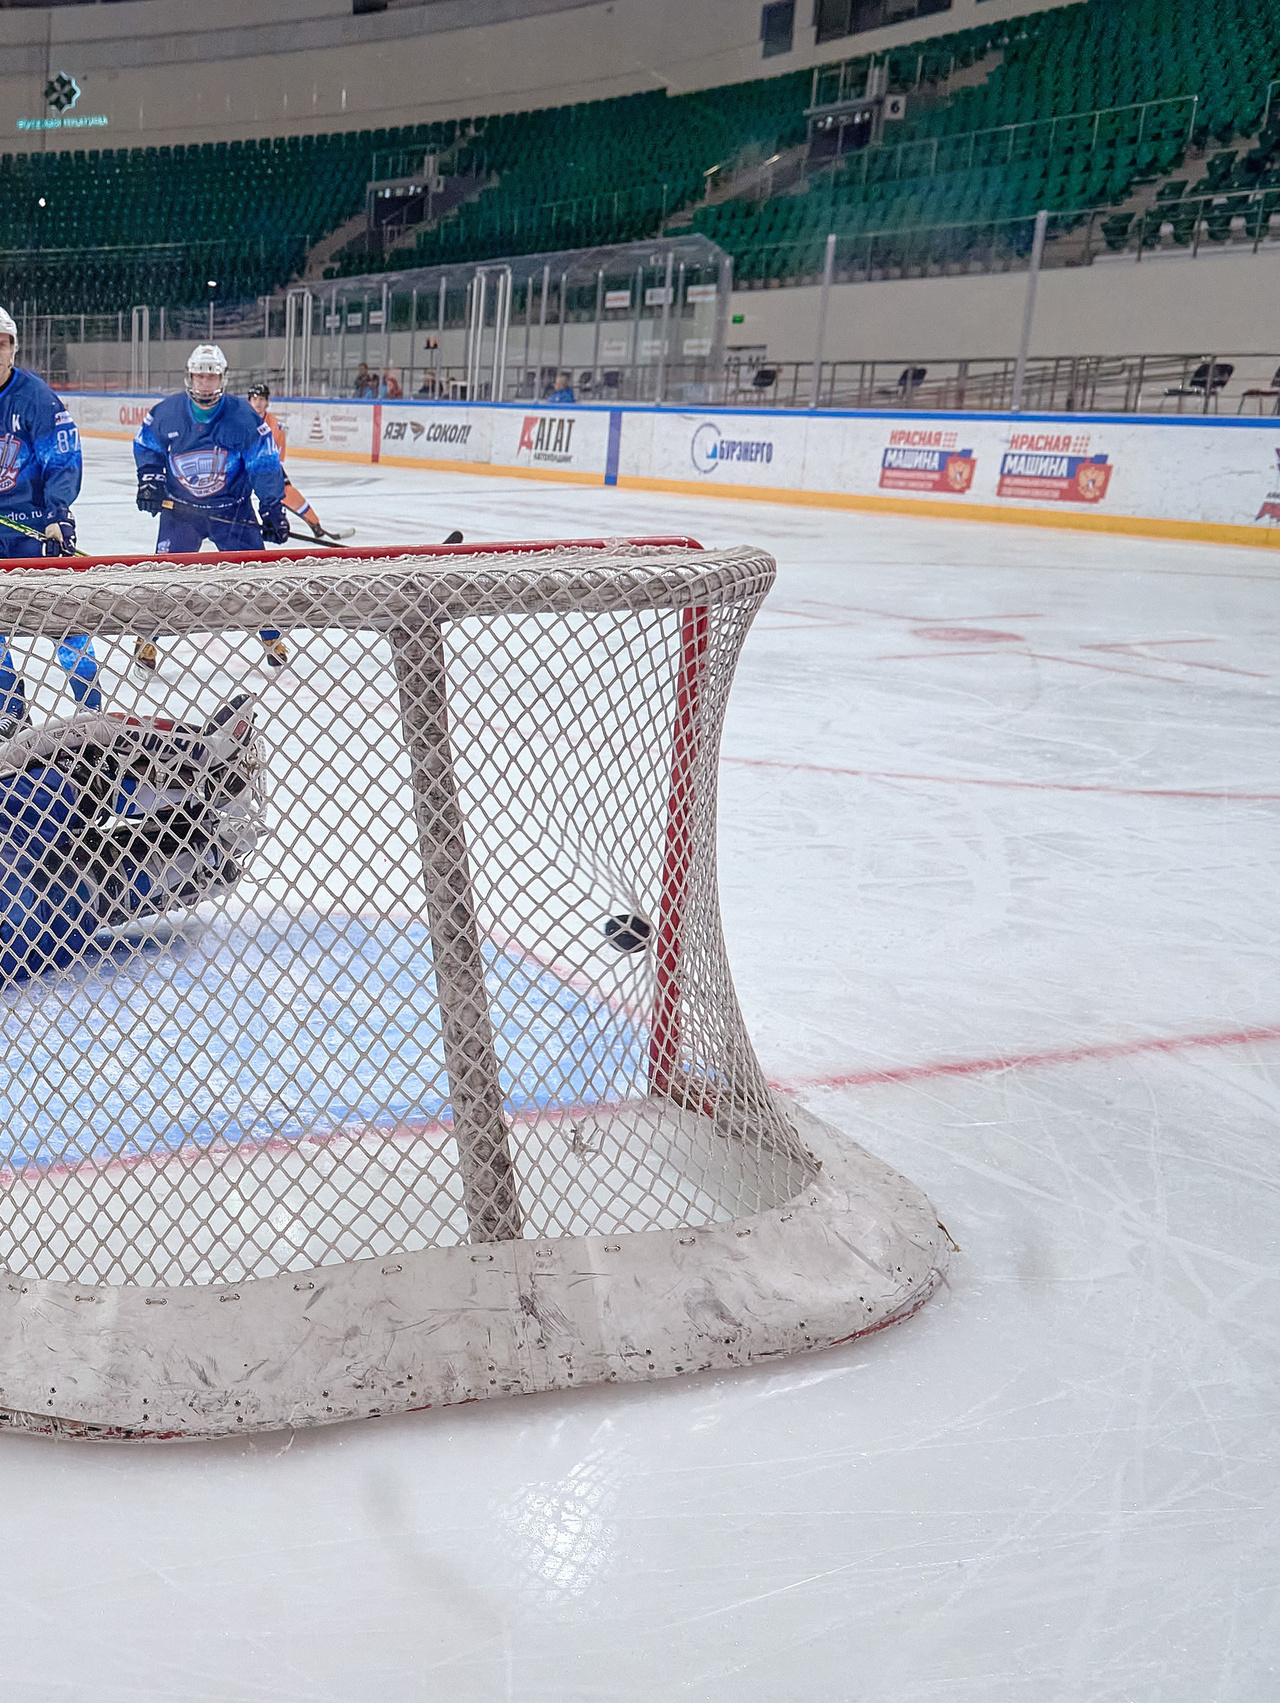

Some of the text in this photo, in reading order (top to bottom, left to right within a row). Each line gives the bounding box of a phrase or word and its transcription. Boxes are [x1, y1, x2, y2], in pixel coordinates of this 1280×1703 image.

[56, 427, 79, 454] 87
[426, 423, 472, 444] СОКОЛ!
[888, 429, 943, 447] КРАСНАЯ
[1009, 433, 1073, 453] КРАСНАЯ
[720, 440, 773, 464] БУРЭНЕРГО
[883, 449, 940, 471] МАШИНА
[1002, 455, 1069, 478] МАШИНА
